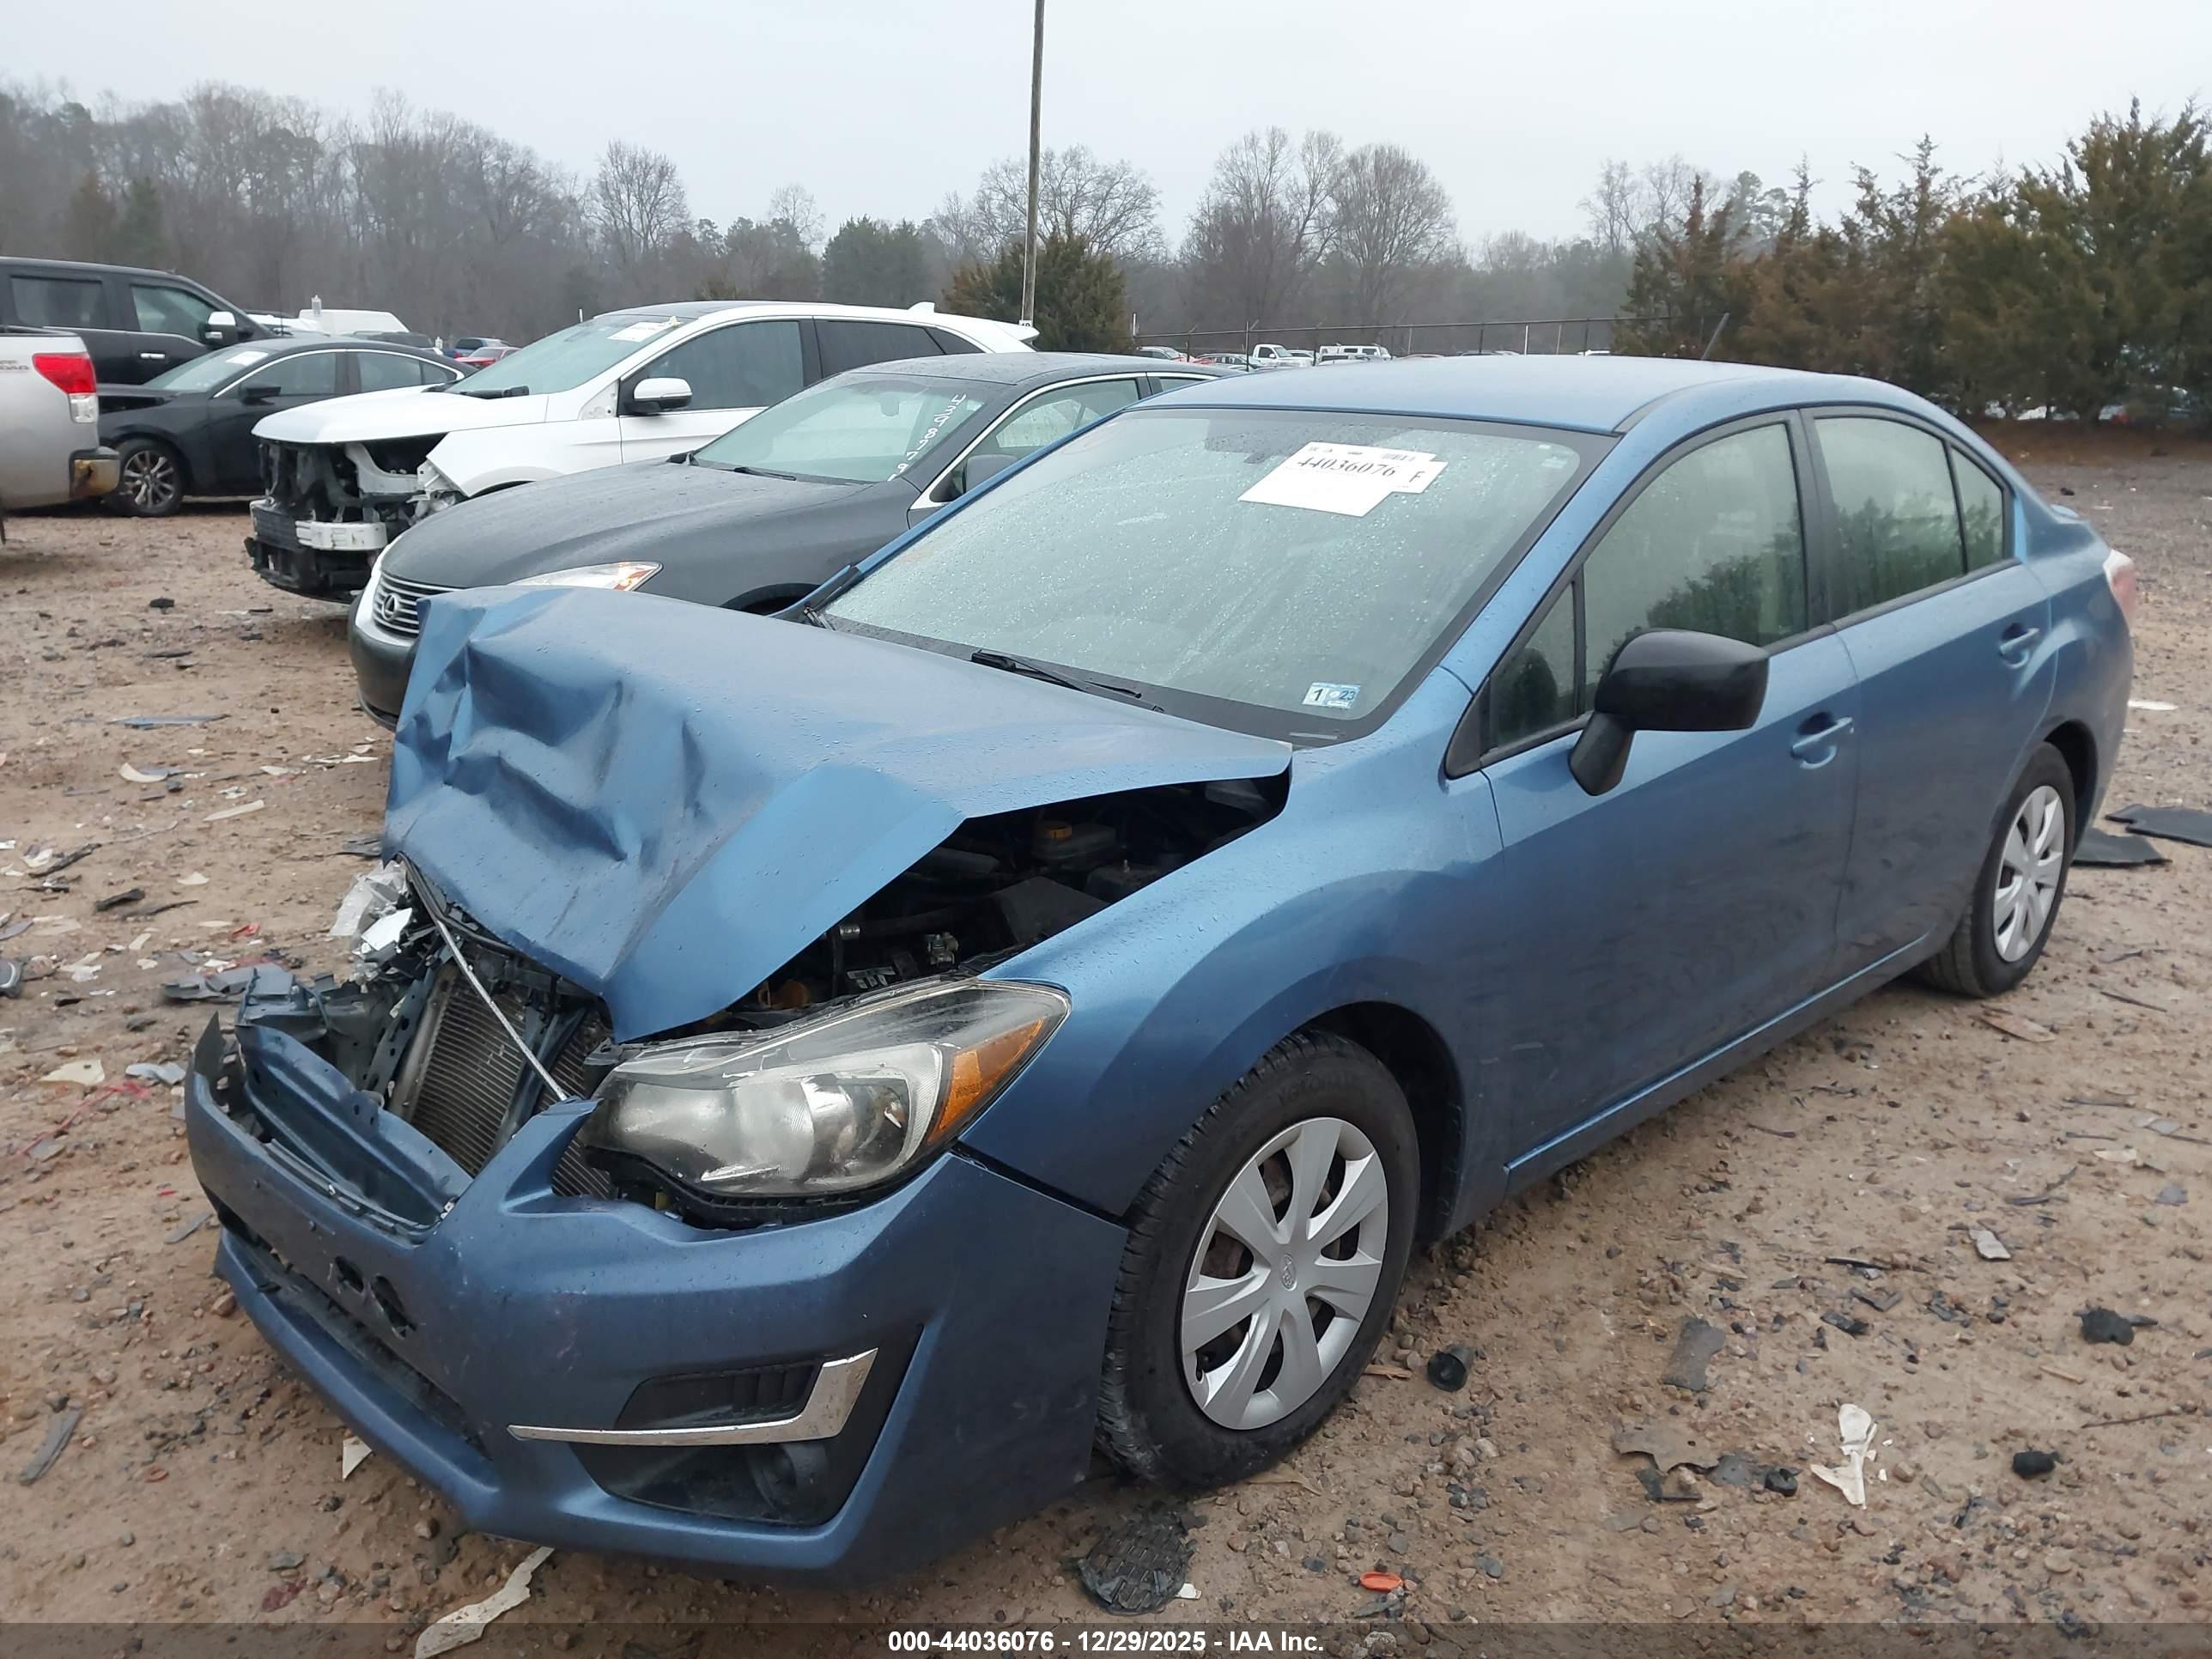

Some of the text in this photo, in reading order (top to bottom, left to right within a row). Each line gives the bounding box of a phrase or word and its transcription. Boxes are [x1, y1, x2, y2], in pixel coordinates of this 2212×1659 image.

[1297, 456, 1396, 477] 44036076
[1313, 688, 1357, 702] 1 23
